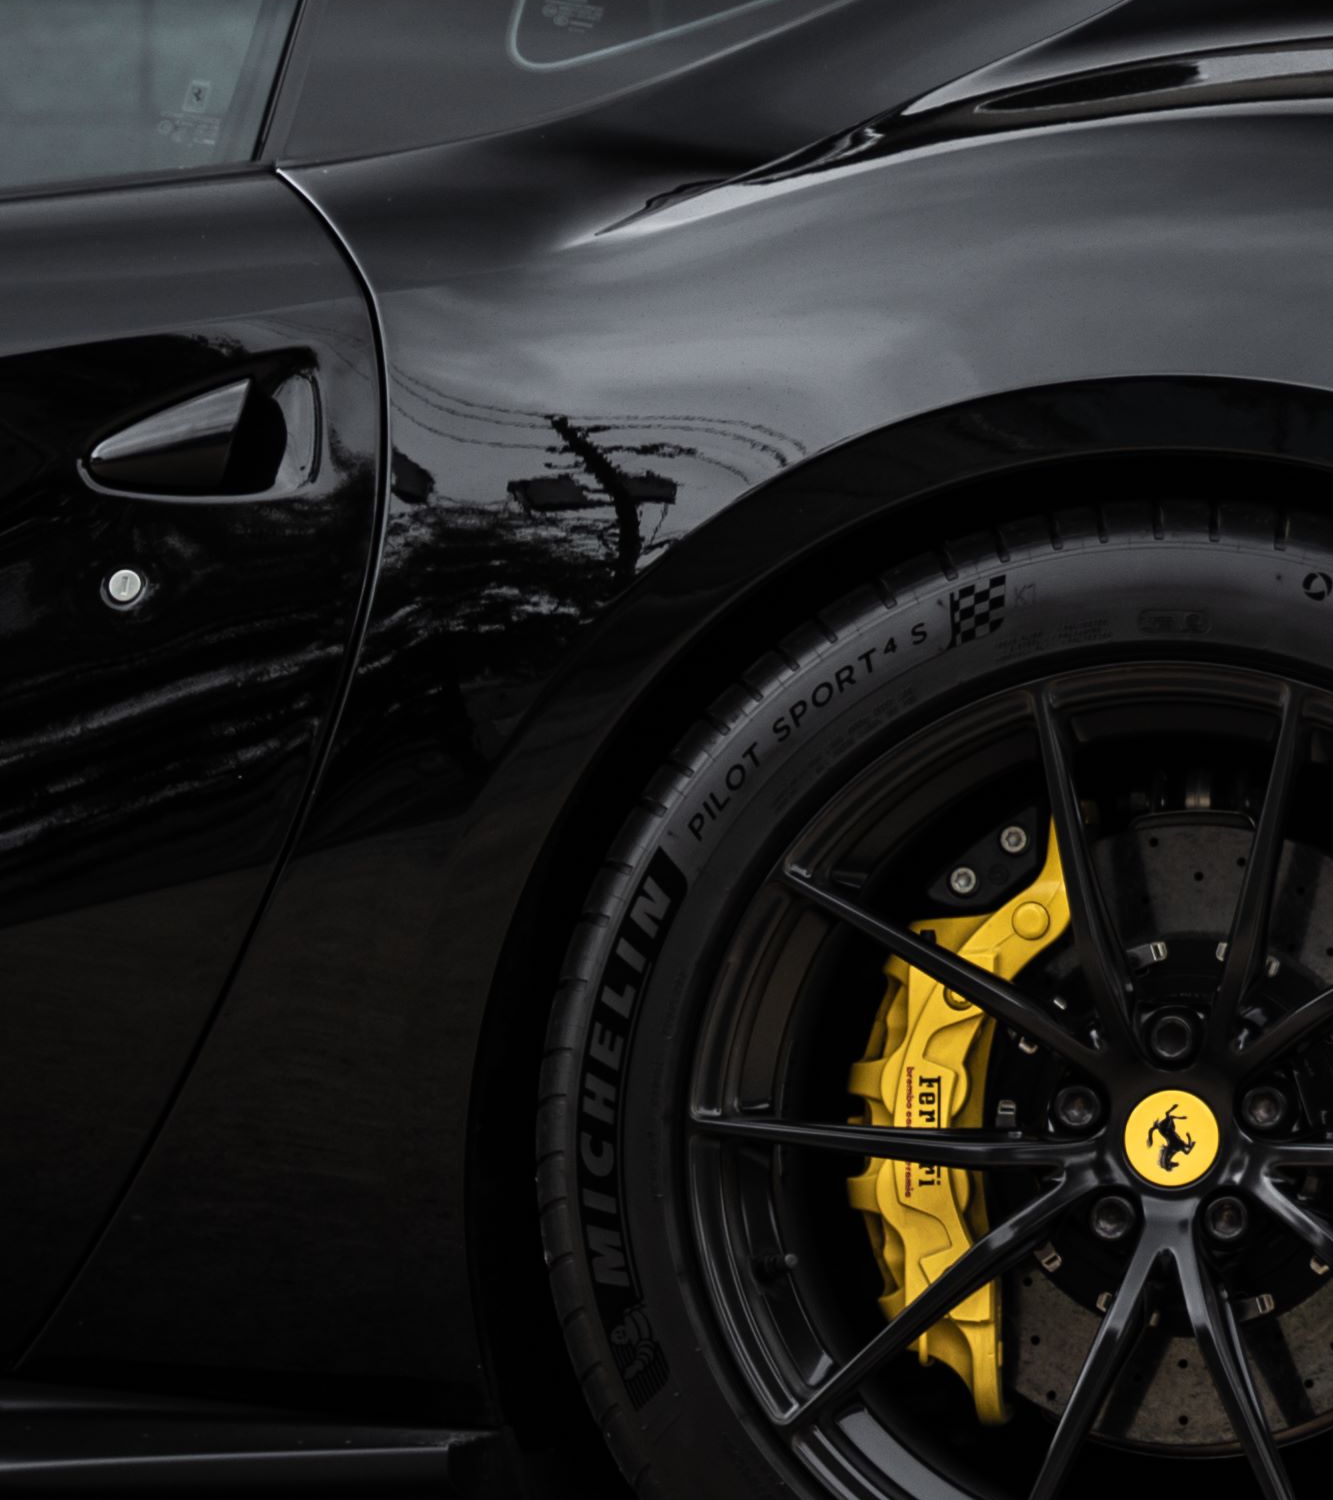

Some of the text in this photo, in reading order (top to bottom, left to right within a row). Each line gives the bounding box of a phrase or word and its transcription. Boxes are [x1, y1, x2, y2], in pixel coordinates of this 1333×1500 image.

[688, 742, 762, 842] PILOT
[582, 875, 673, 1288] MICHELIN
[919, 1075, 942, 1187] Ferri
